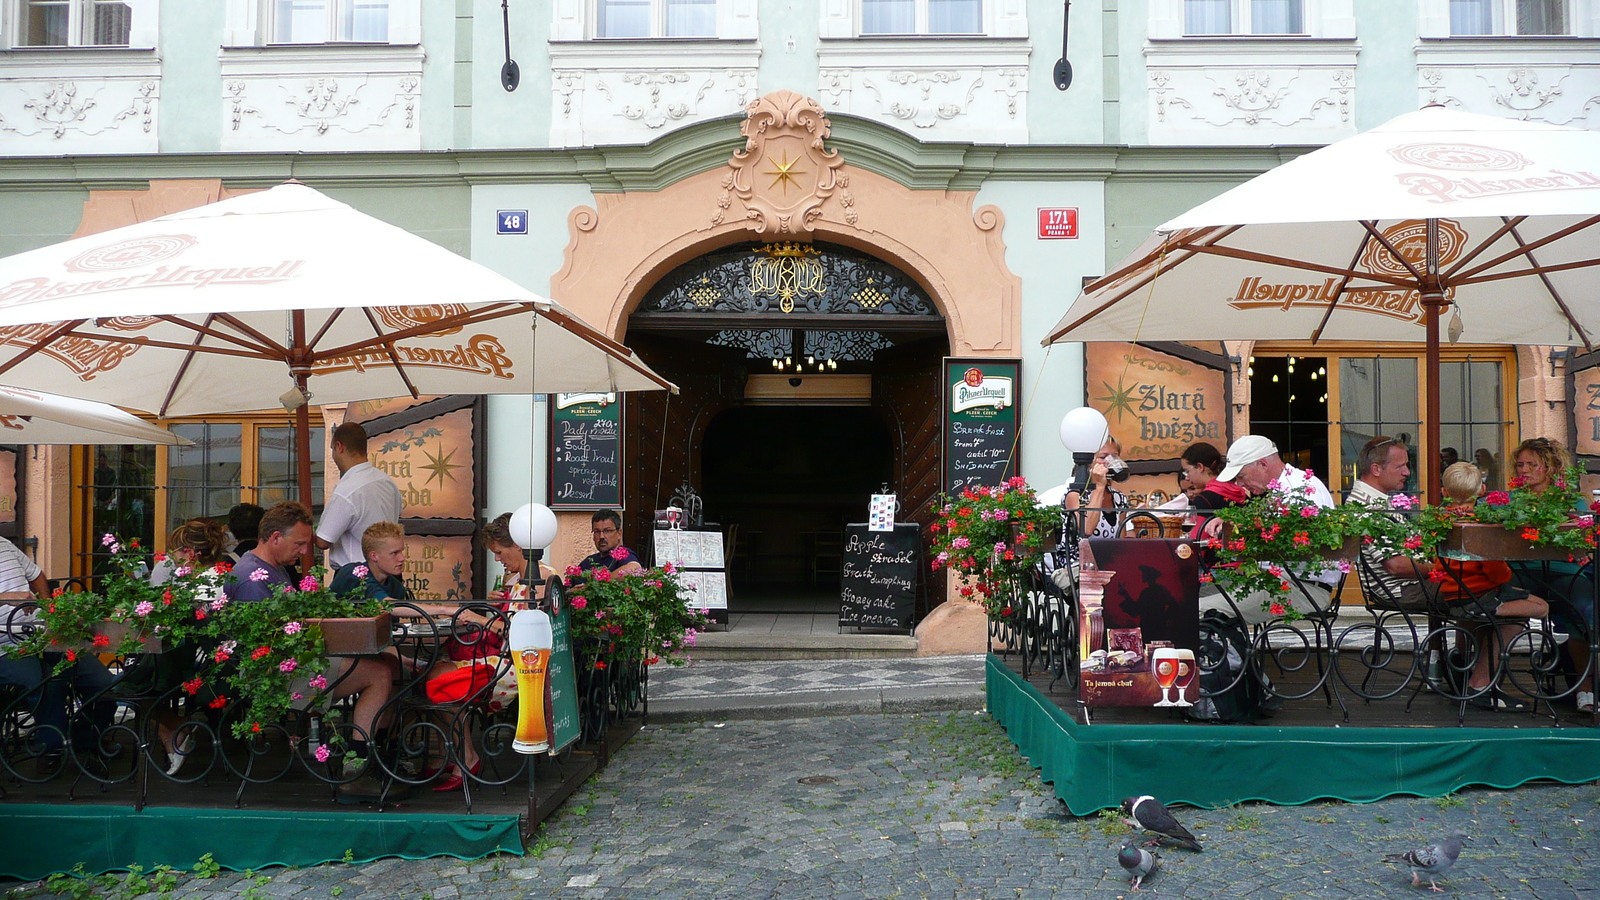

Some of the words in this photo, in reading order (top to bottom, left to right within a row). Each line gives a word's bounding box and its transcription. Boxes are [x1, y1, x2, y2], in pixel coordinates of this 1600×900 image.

[1394, 172, 1568, 204] Pilsner
[504, 215, 520, 229] 48
[1049, 211, 1068, 224] 171
[0, 274, 151, 306] Pilsner
[143, 260, 305, 289] Urquell
[959, 387, 983, 403] Pilsner
[982, 387, 1006, 399] Urquell
[1138, 384, 1206, 411] Zlatá
[1137, 413, 1220, 443] hvězda
[564, 451, 590, 462] Roast
[592, 449, 615, 463] Trout
[565, 440, 590, 457] Soup
[371, 453, 412, 478] latá
[562, 482, 594, 499] Dessert
[845, 534, 886, 555] Apple
[843, 562, 873, 578] Fruit
[841, 587, 871, 610] Honey
[873, 595, 895, 609] cake
[840, 605, 858, 621] Ice
[861, 614, 899, 627] cream
